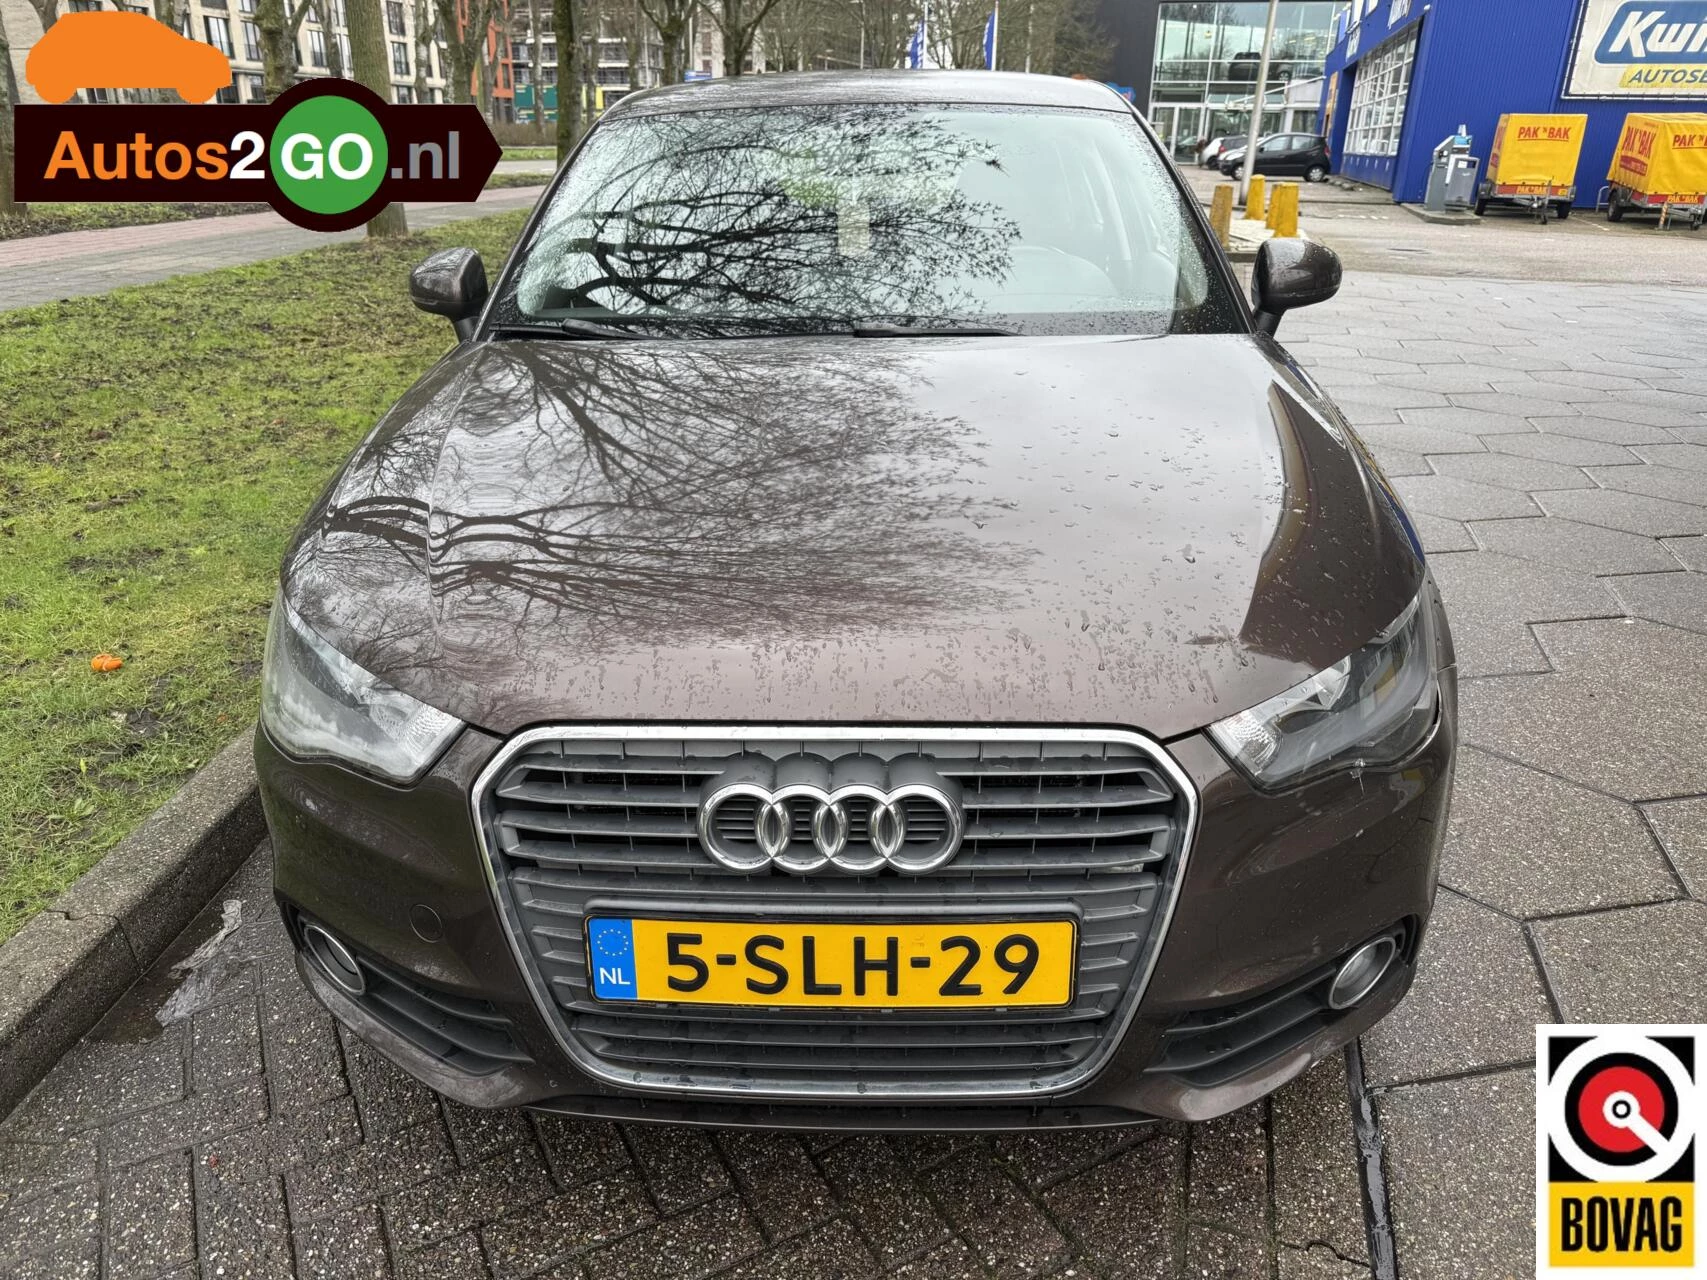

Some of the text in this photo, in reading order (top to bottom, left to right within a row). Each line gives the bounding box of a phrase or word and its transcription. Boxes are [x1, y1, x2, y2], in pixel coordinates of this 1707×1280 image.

[1609, 11, 1707, 57] Kwi
[1518, 127, 1540, 138] PAK
[1548, 127, 1571, 139] BAK
[1673, 134, 1696, 147] PAK
[667, 932, 1040, 996] 5-SLH-29
[600, 967, 631, 986] NL
